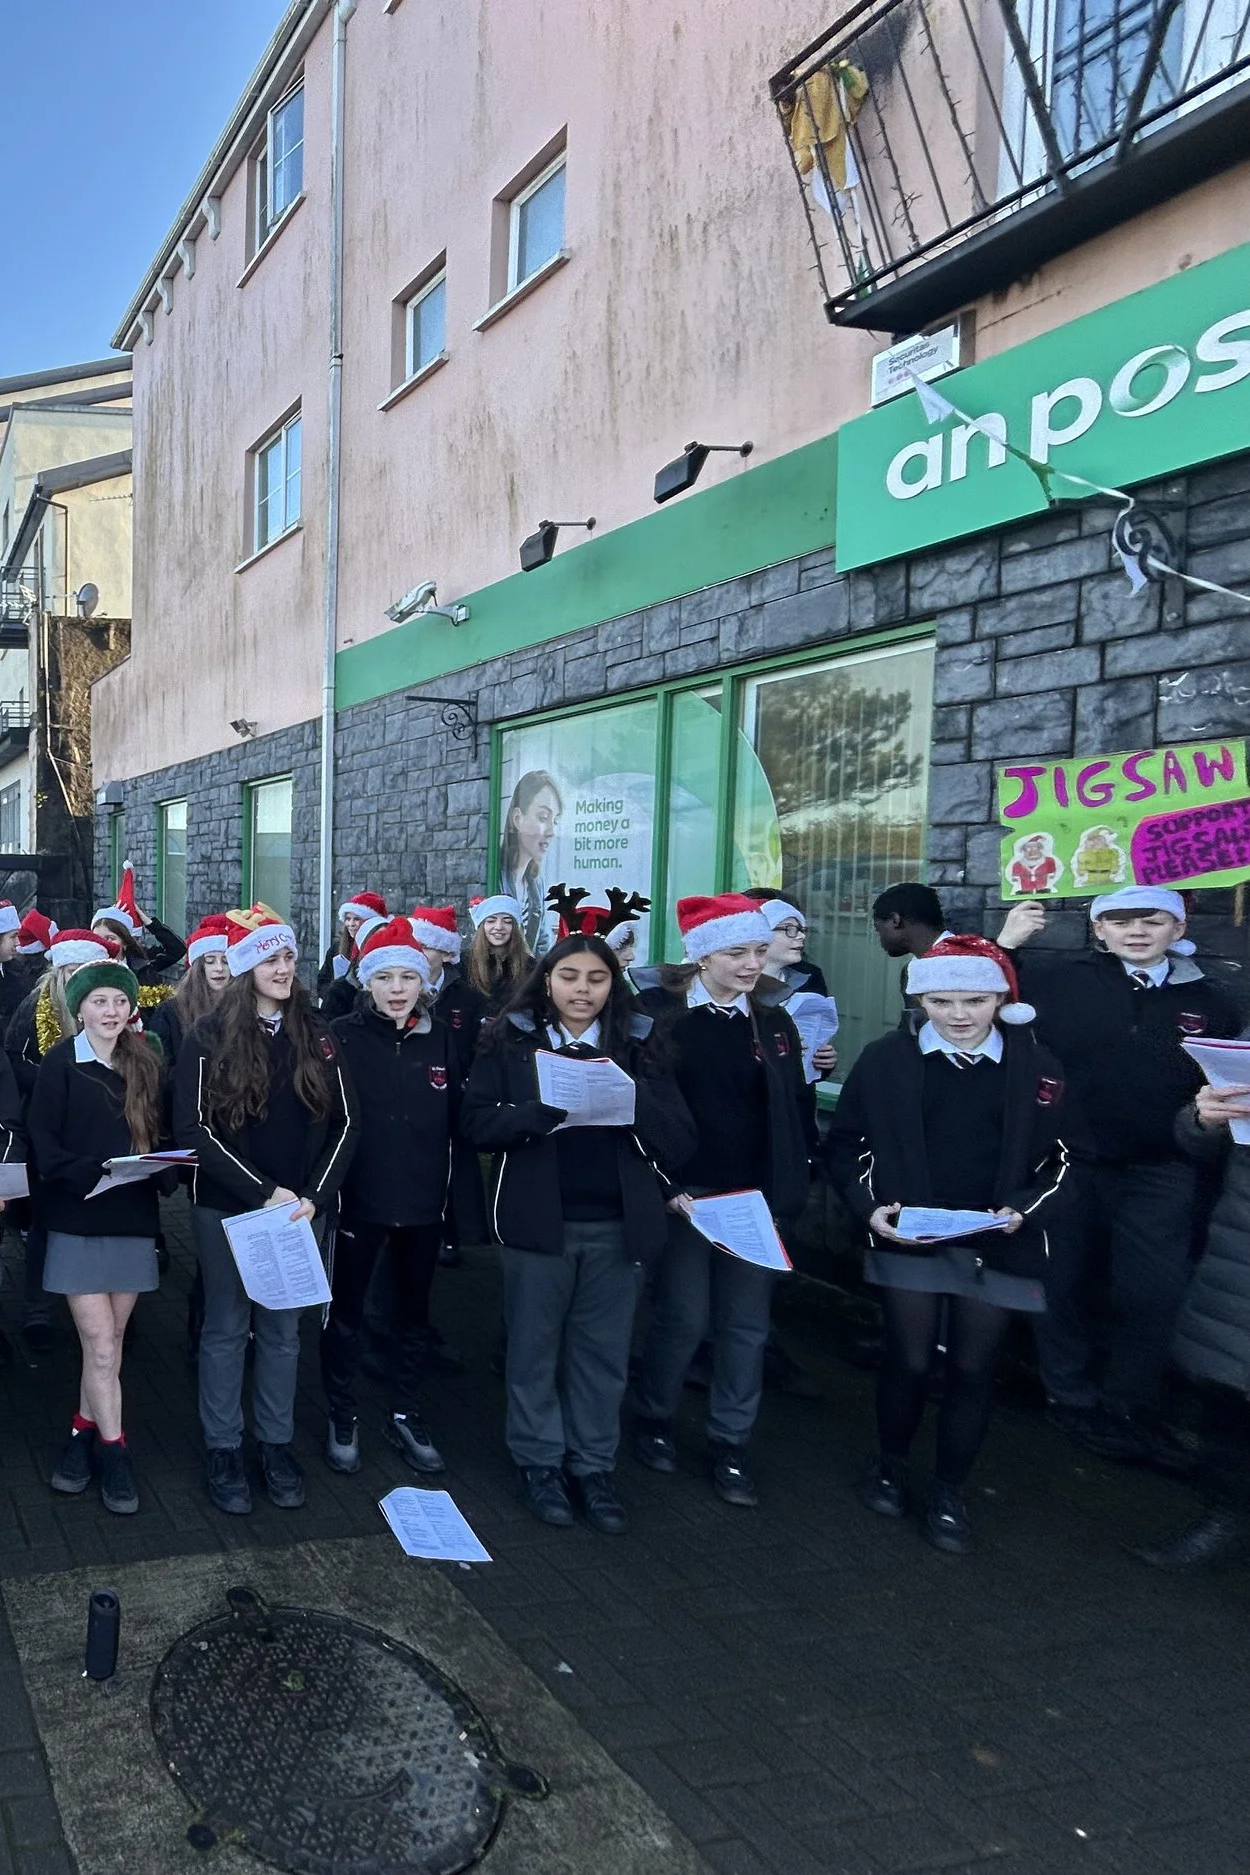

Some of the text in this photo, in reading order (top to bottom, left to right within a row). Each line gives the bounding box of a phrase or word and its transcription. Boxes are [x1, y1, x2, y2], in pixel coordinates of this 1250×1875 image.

[888, 340, 931, 366] Securitas
[888, 345, 939, 374] Technology
[886, 411, 1007, 500] an
[1003, 745, 1235, 819] JIGSAW
[575, 798, 624, 815] Making
[574, 818, 630, 833] money a
[574, 837, 629, 851] bit more
[573, 855, 623, 869] human.
